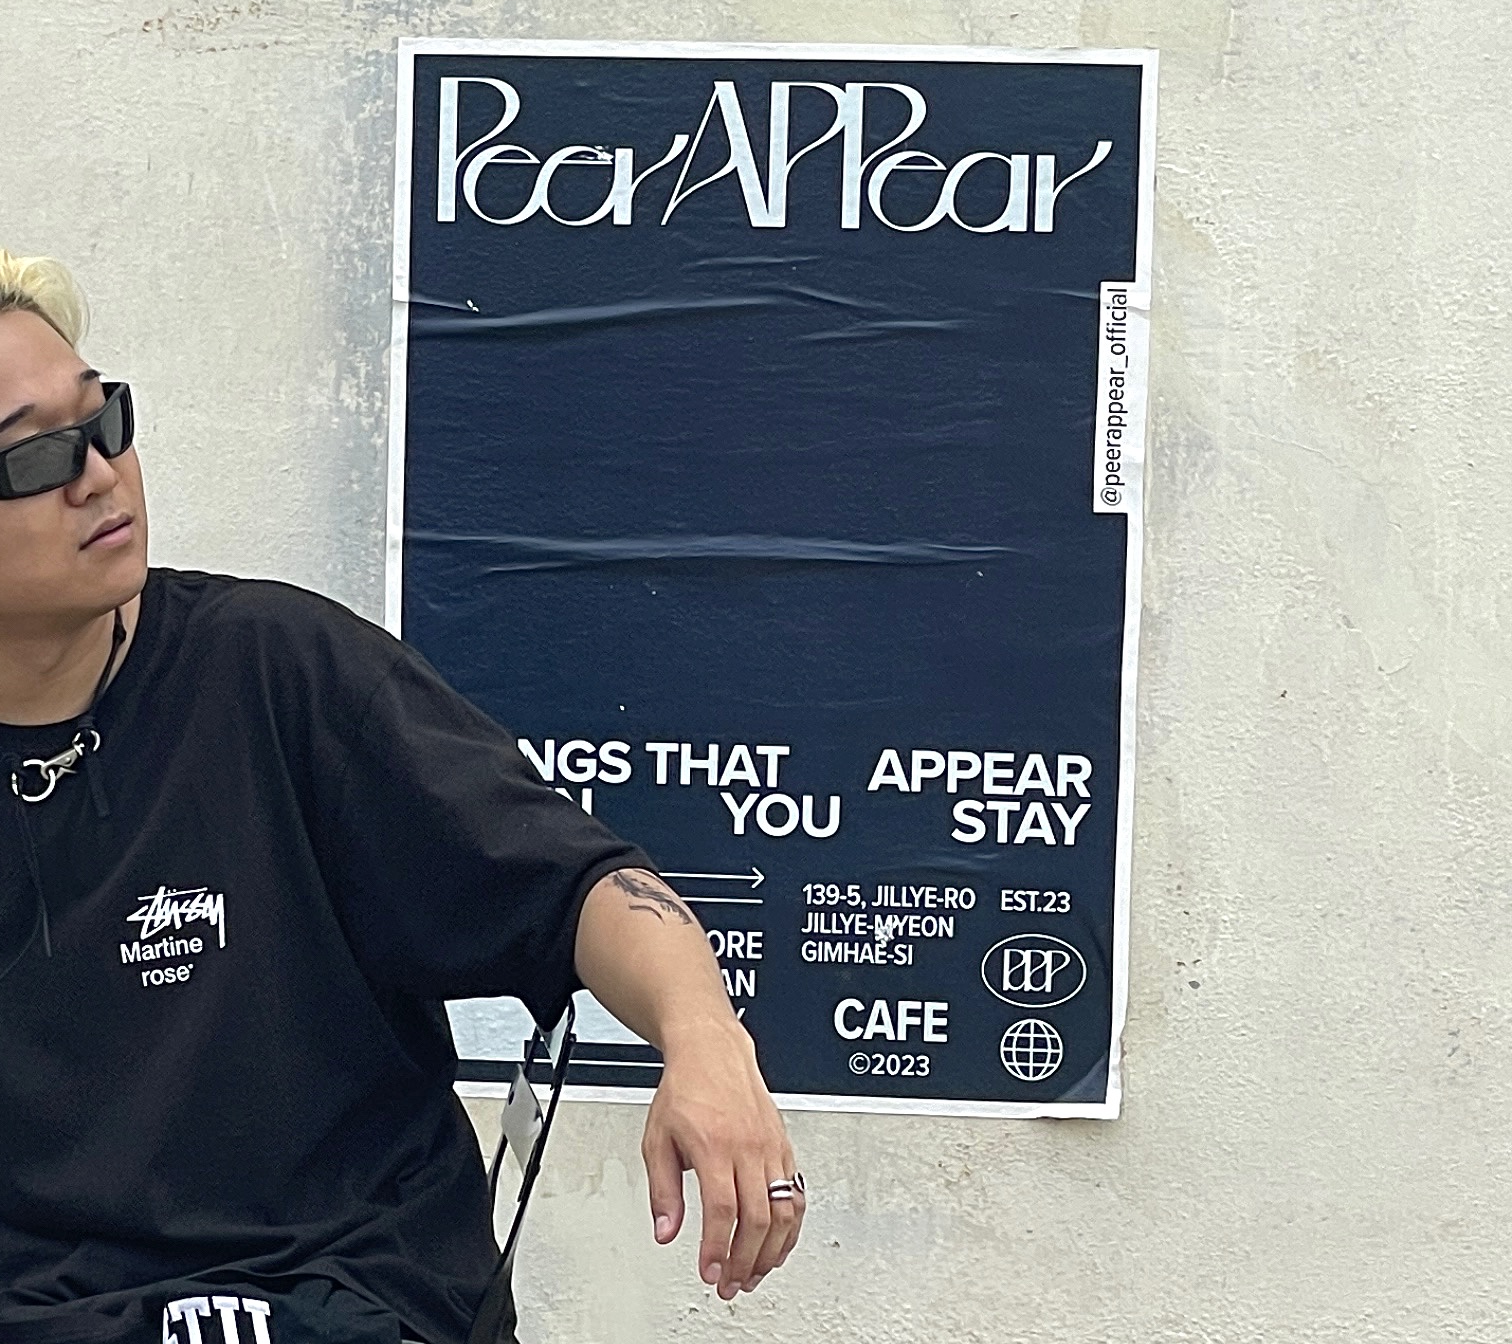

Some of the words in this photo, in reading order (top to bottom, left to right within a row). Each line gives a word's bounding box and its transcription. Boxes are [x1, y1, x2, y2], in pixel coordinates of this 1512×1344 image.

[1100, 288, 1129, 506] @peerappear_official
[645, 742, 790, 788] THAT
[867, 749, 1092, 798] APPEAR
[720, 792, 841, 838] YOU
[951, 799, 1091, 846] STAY
[802, 883, 867, 909] 139-5,
[871, 885, 976, 910] JILLYE-RO
[1000, 889, 1071, 913] EST.23
[801, 912, 954, 939] JILLYE-MYEON
[120, 936, 203, 964] Martine
[801, 940, 913, 966] GIMHAE-SI
[834, 998, 949, 1043] CAFE
[848, 1052, 930, 1077] ©2023
